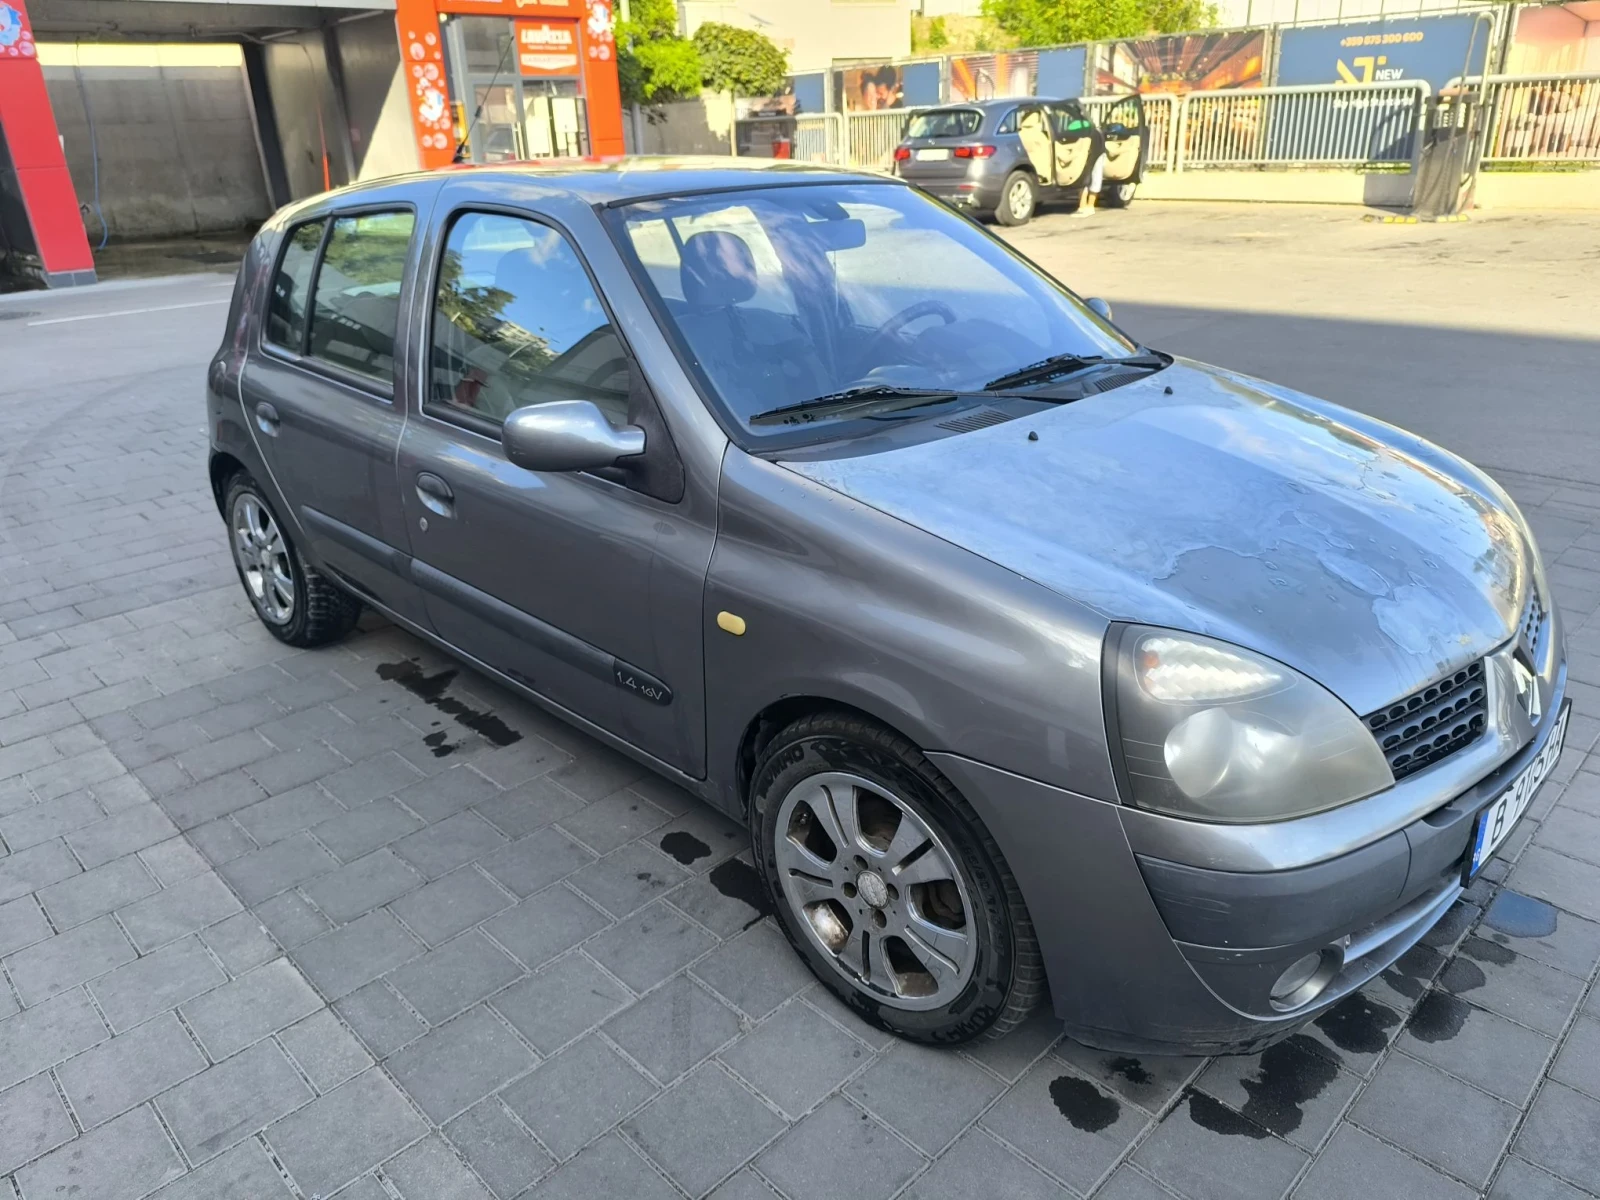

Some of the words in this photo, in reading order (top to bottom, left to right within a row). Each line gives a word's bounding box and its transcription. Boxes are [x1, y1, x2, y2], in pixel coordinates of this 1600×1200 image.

[1375, 68, 1404, 80] NEW
[617, 671, 637, 689] 1.4
[641, 685, 662, 700] 16V
[1491, 799, 1507, 846] B
